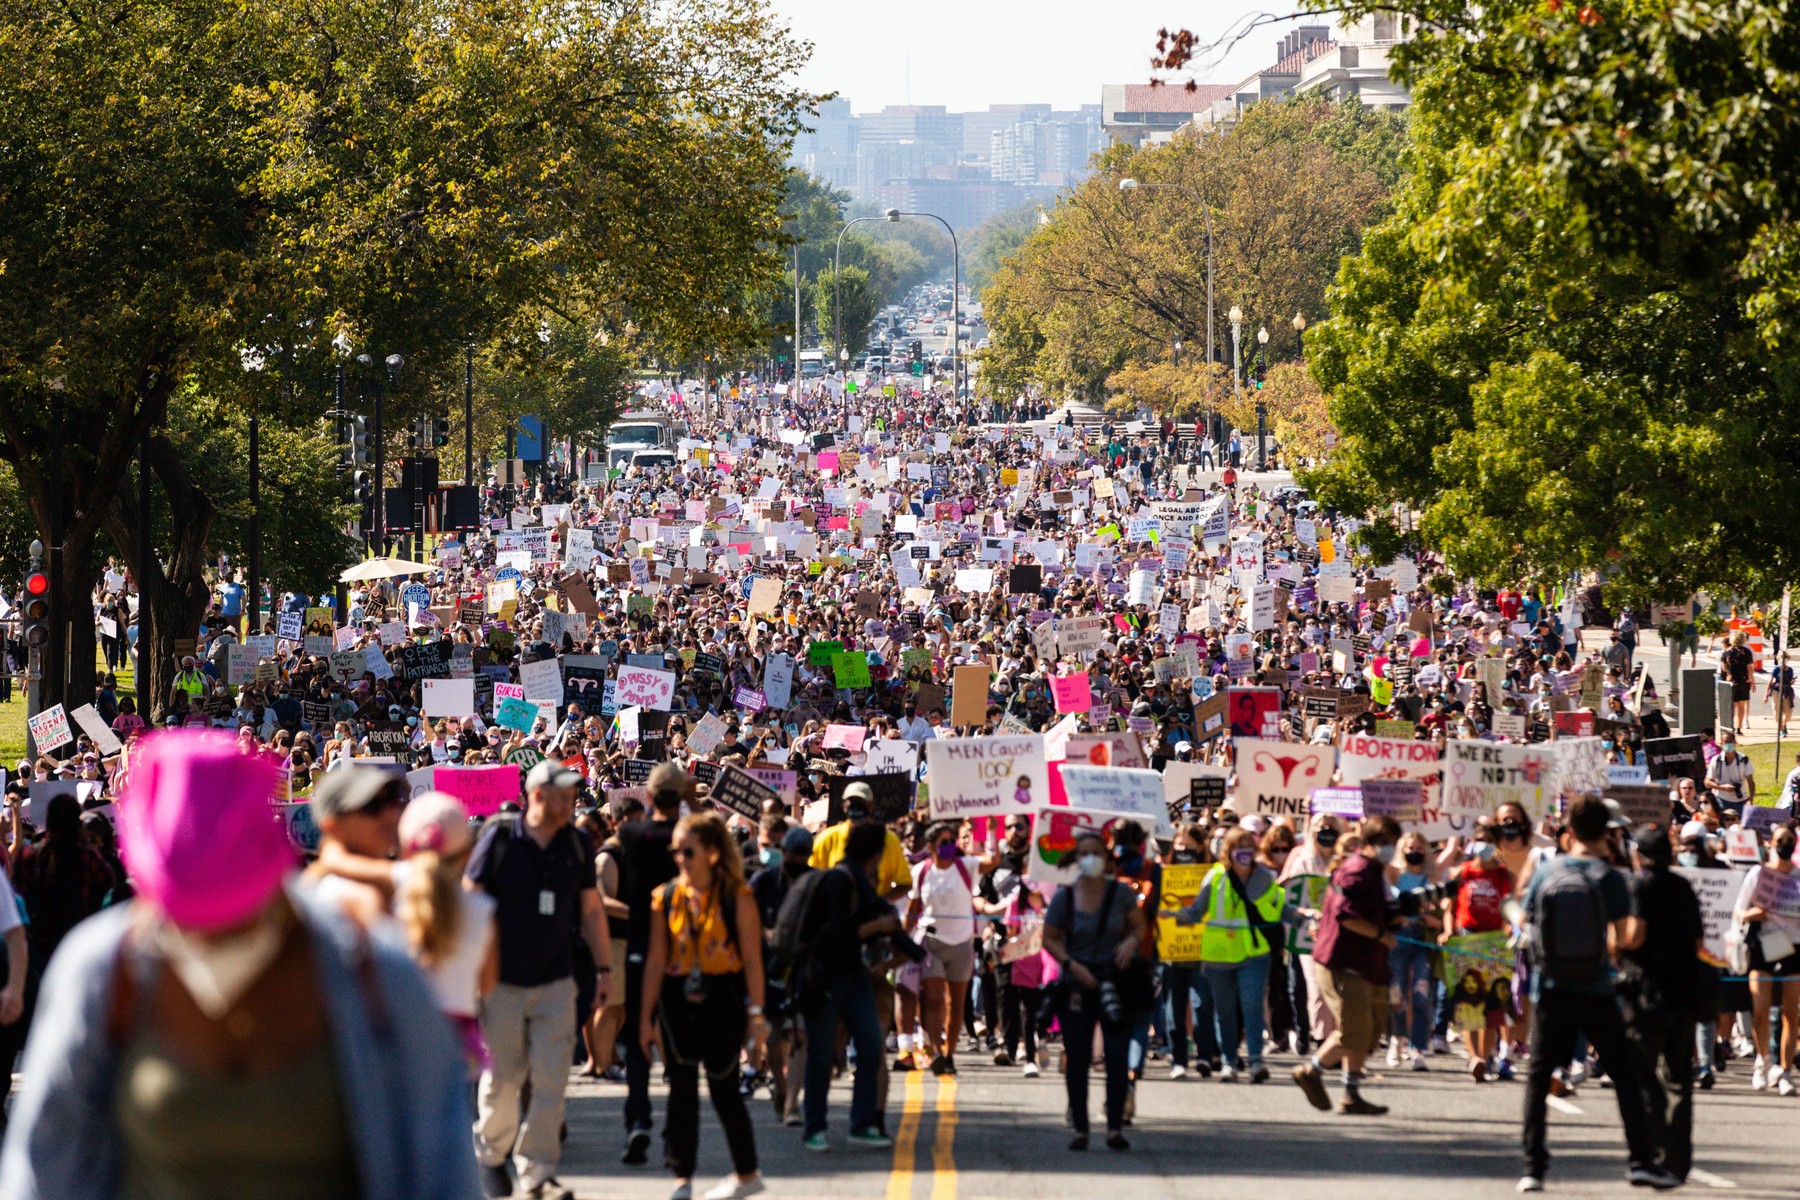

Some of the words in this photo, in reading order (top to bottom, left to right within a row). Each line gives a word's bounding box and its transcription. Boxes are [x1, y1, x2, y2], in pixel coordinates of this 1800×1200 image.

[1153, 514, 1176, 522] ONCE
[1178, 514, 1195, 522] AND
[505, 537, 512, 546] I
[497, 545, 518, 553] MARCH
[499, 569, 518, 579] KEEP
[407, 586, 426, 595] KEEP
[330, 652, 354, 661] Grow
[418, 655, 440, 666] THE
[334, 659, 353, 668] Pair
[626, 672, 662, 688] PUSSY
[495, 684, 523, 698] GIRLS
[637, 684, 645, 693] IS
[621, 689, 658, 706] POWER
[30, 717, 40, 728] IF
[51, 706, 62, 718] MY
[32, 713, 66, 734] VAGINA
[1263, 711, 1281, 723] WE
[1261, 723, 1281, 736] ARE
[38, 734, 67, 752] REGULATE
[369, 730, 406, 744] ABORTION
[382, 742, 392, 752] IS
[946, 744, 984, 760] MEN
[989, 740, 1035, 758] Cause
[1340, 738, 1439, 762] ABORTION
[506, 748, 540, 770] ERA
[758, 771, 784, 782] BANS
[876, 765, 903, 775] WITH
[1479, 767, 1519, 784] NOT
[457, 773, 501, 790] MORE
[729, 770, 751, 787] KEEP
[984, 779, 1000, 790] of
[1193, 780, 1207, 788] KEEP
[1208, 780, 1224, 788] YOUR
[725, 782, 747, 800] LAWS
[1194, 789, 1210, 798] LAWS
[1211, 789, 1223, 797] OFF
[1365, 785, 1381, 793] OUR
[496, 792, 510, 805] A
[720, 792, 735, 805] MY
[733, 800, 757, 818] BODY
[933, 795, 1001, 814] Unplanned
[1256, 793, 1311, 815] MINE
[1166, 878, 1201, 892] ROSARI
[1167, 943, 1203, 957] OVARI
